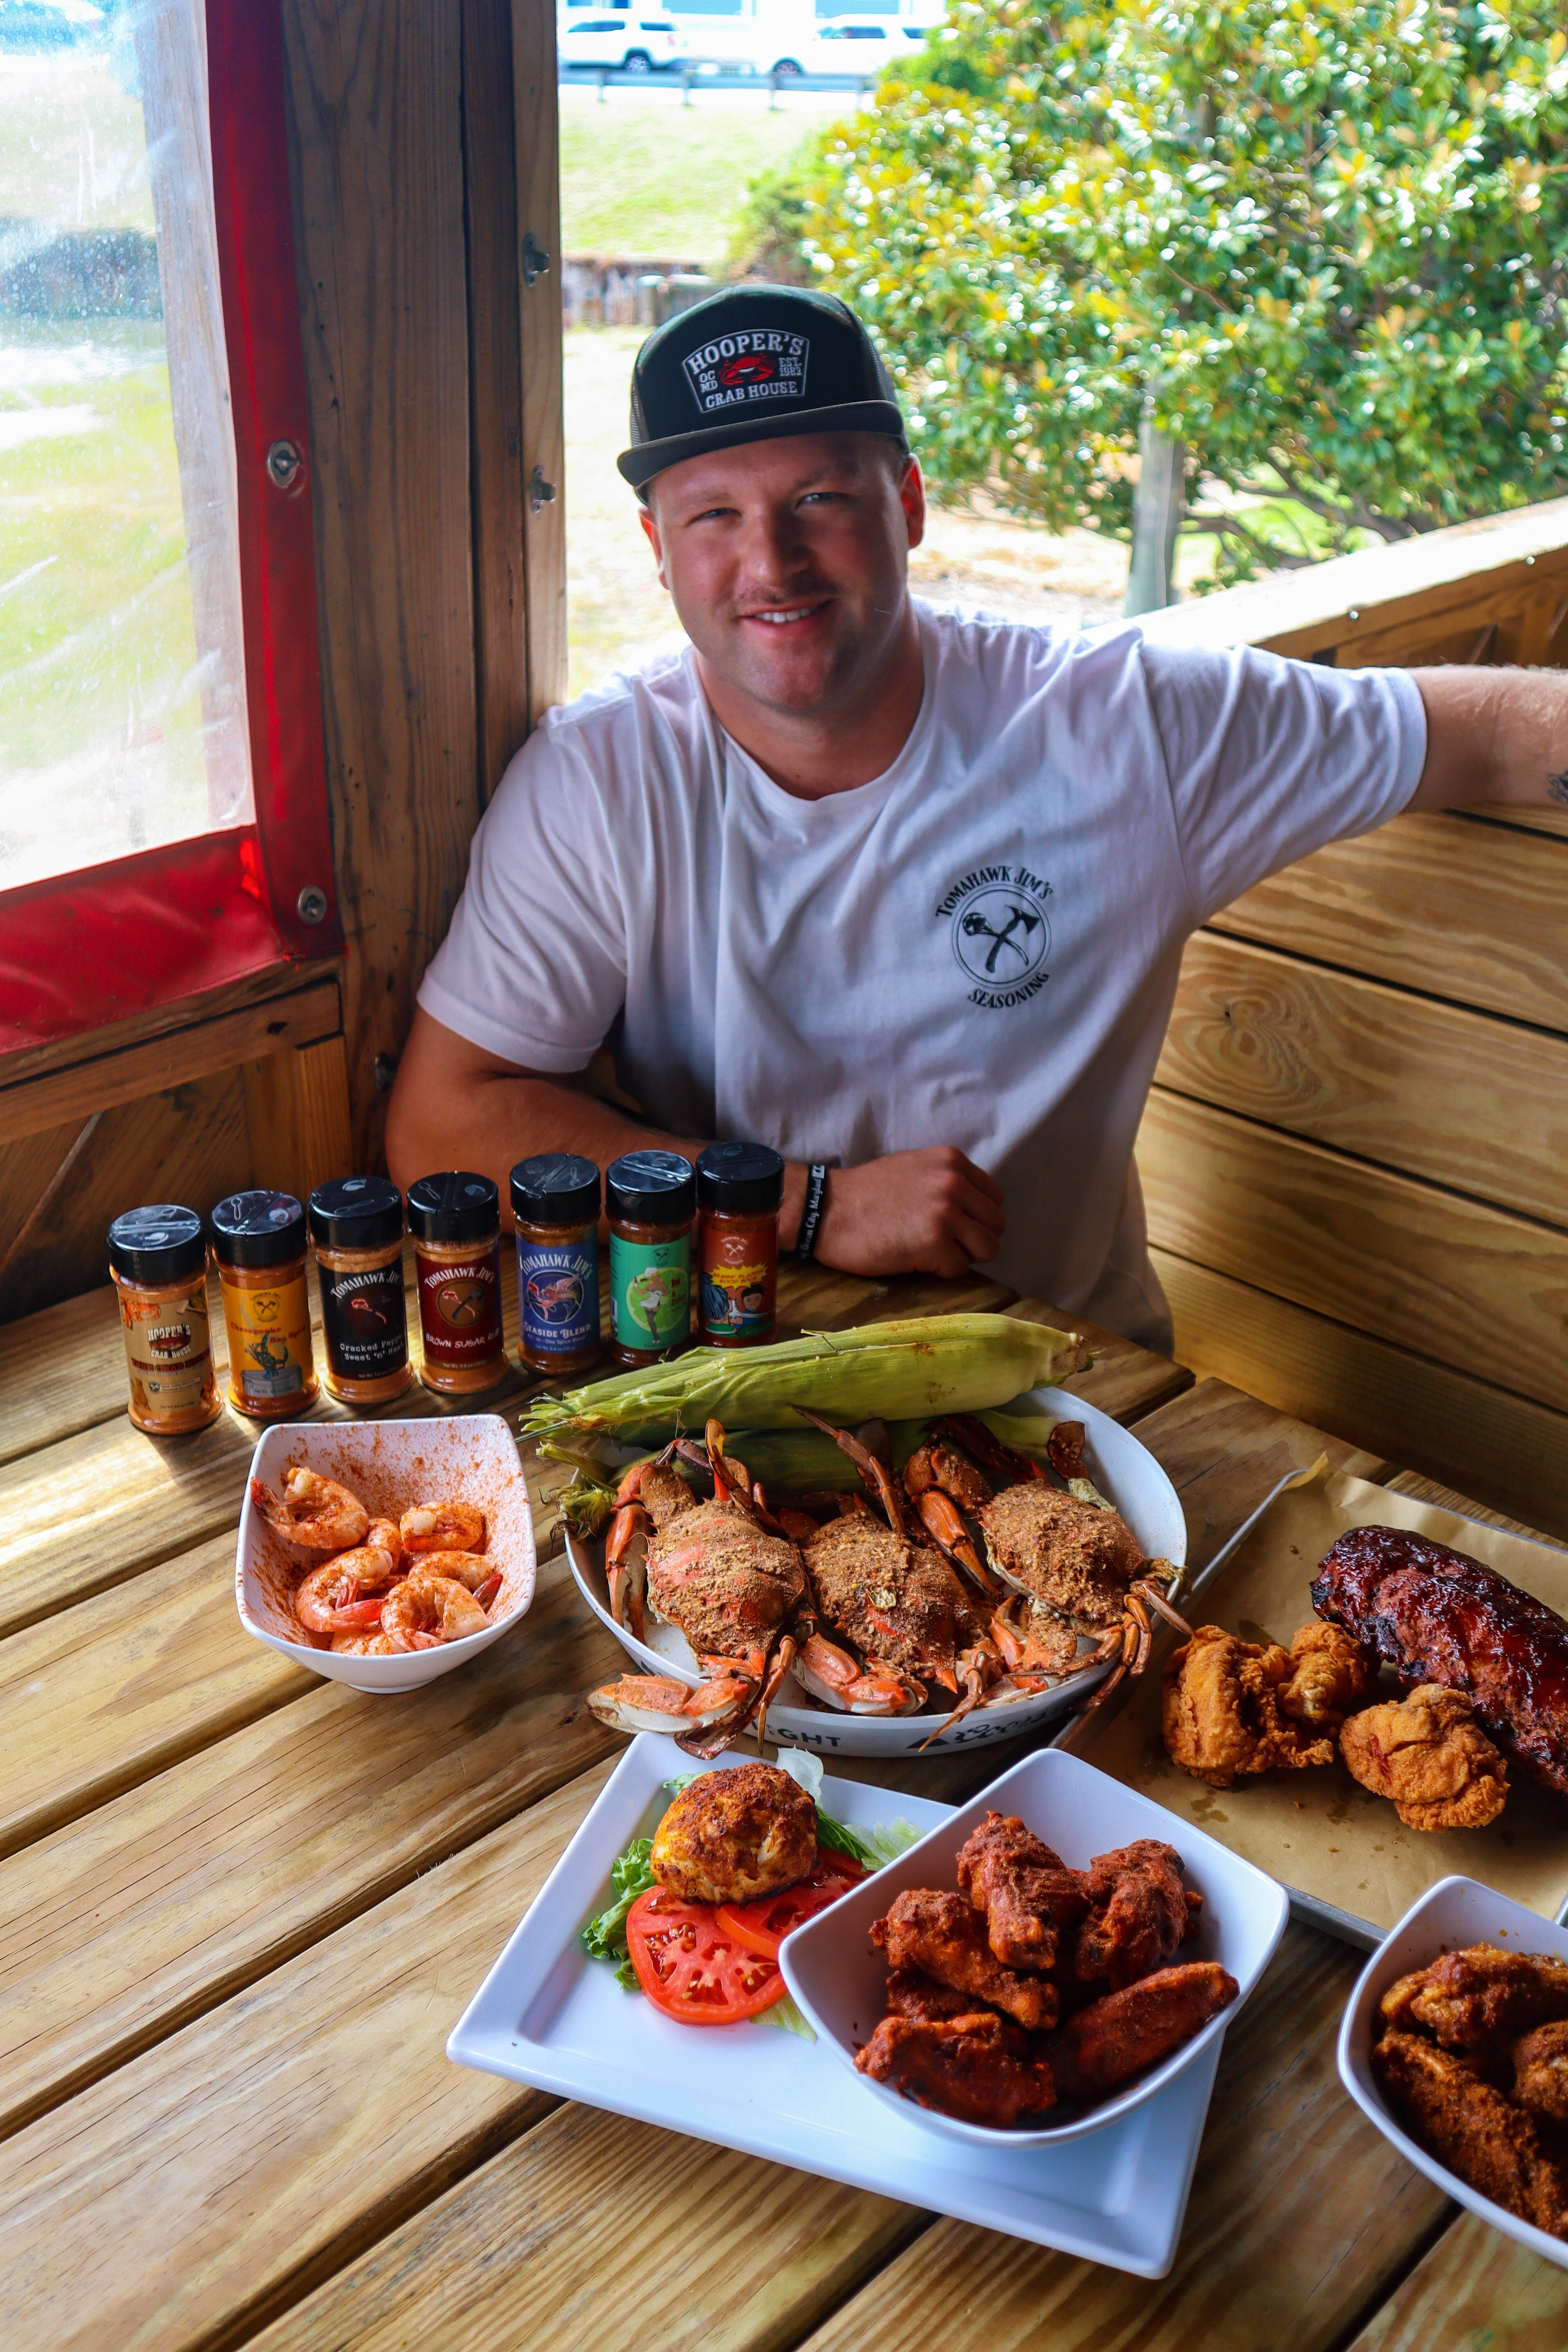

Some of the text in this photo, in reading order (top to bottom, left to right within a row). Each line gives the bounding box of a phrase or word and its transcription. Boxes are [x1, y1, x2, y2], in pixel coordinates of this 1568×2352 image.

[688, 332, 804, 374] HOOPER'S
[778, 357, 802, 367] EST.
[698, 370, 715, 383] OC
[700, 380, 718, 393] MD
[705, 381, 797, 408] CRAB HOUSE
[935, 865, 1054, 917] TOMAHAWK JIM'S
[968, 971, 1050, 1009] SEASONING
[521, 1254, 571, 1275] TOMAHAWK
[572, 1254, 592, 1280] JIM'S
[330, 1272, 385, 1299] TOMAHAWK
[424, 1267, 495, 1289] TOMAHAWK JIM'S
[147, 1323, 191, 1341] HOOPER'S
[230, 1322, 281, 1335] Chesapeake
[523, 1321, 590, 1339] SEASIDE BLEND
[340, 1343, 377, 1352] Cracked
[426, 1333, 451, 1348] BROWN
[454, 1336, 485, 1348] SUGAR
[151, 1345, 191, 1359] CRAB HOUSE
[344, 1353, 370, 1361] Sweet
[388, 1342, 403, 1355] Heat
[155, 1362, 184, 1373] CRAB
